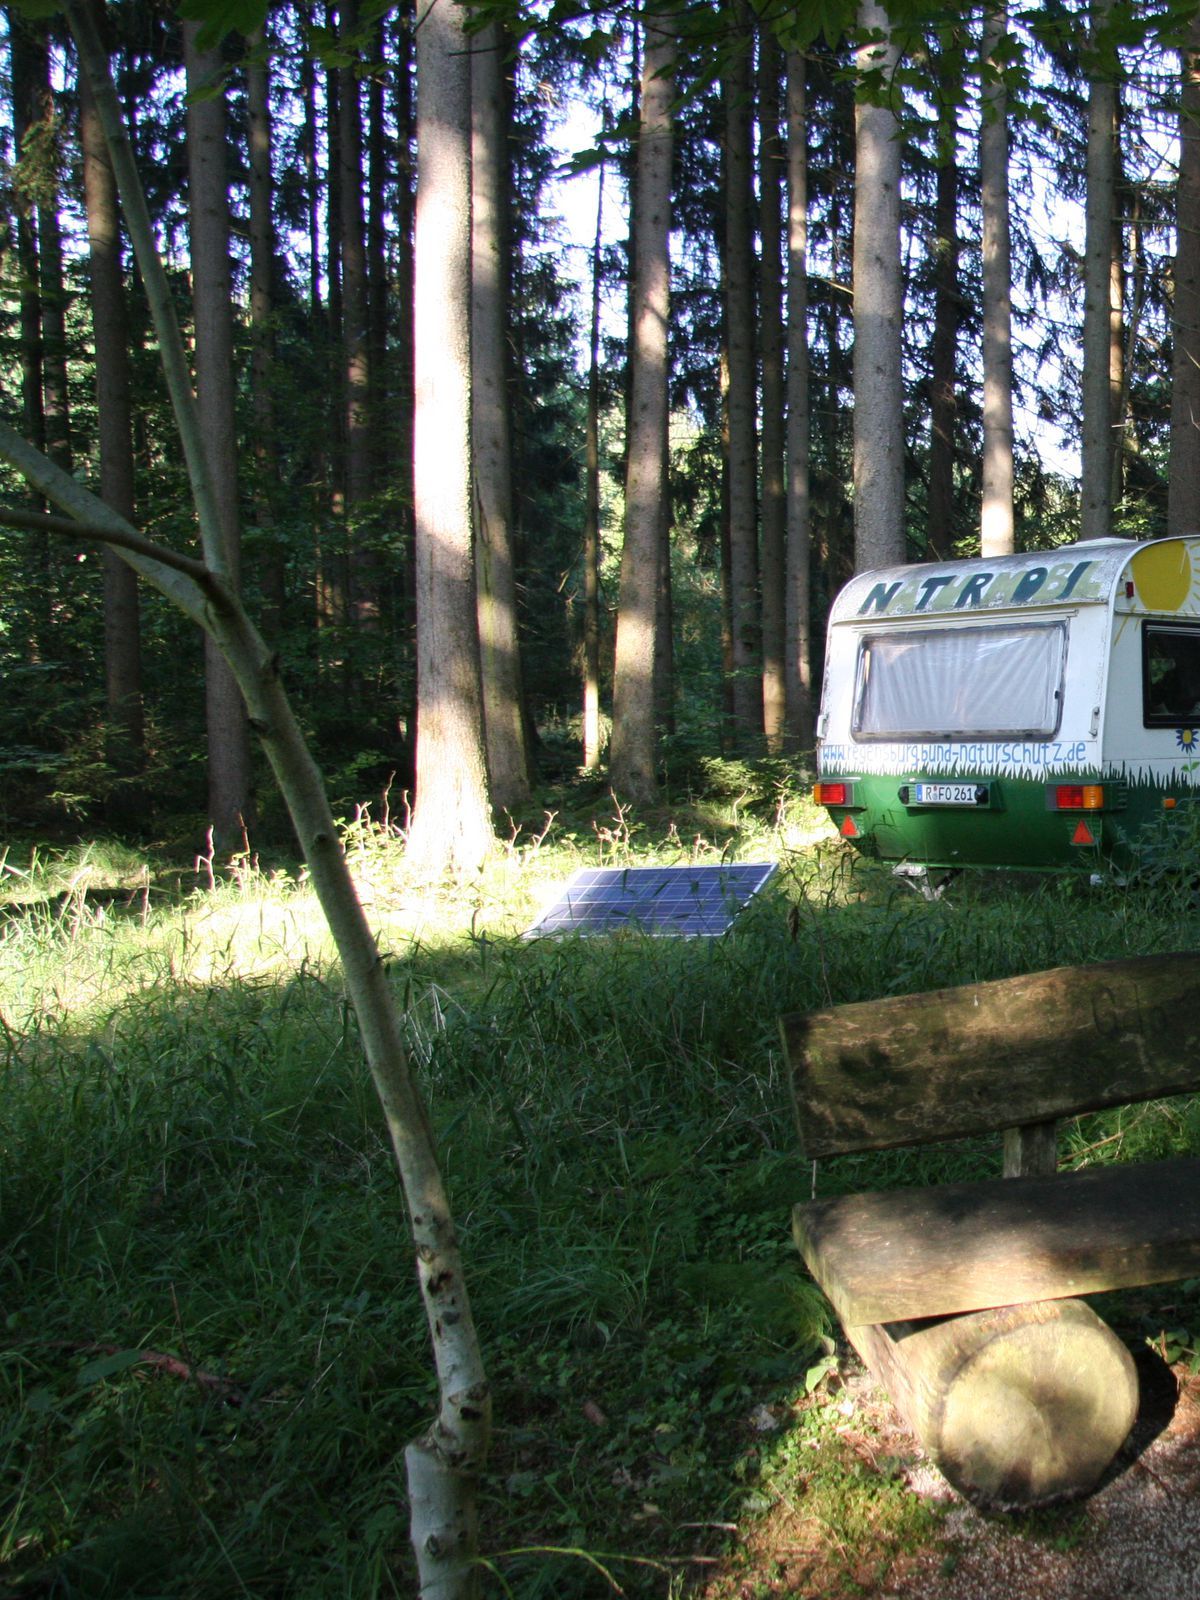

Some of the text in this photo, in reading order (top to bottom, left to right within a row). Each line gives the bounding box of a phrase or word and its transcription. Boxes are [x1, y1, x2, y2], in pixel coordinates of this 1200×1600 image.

[925, 786, 973, 801] R FO 261
